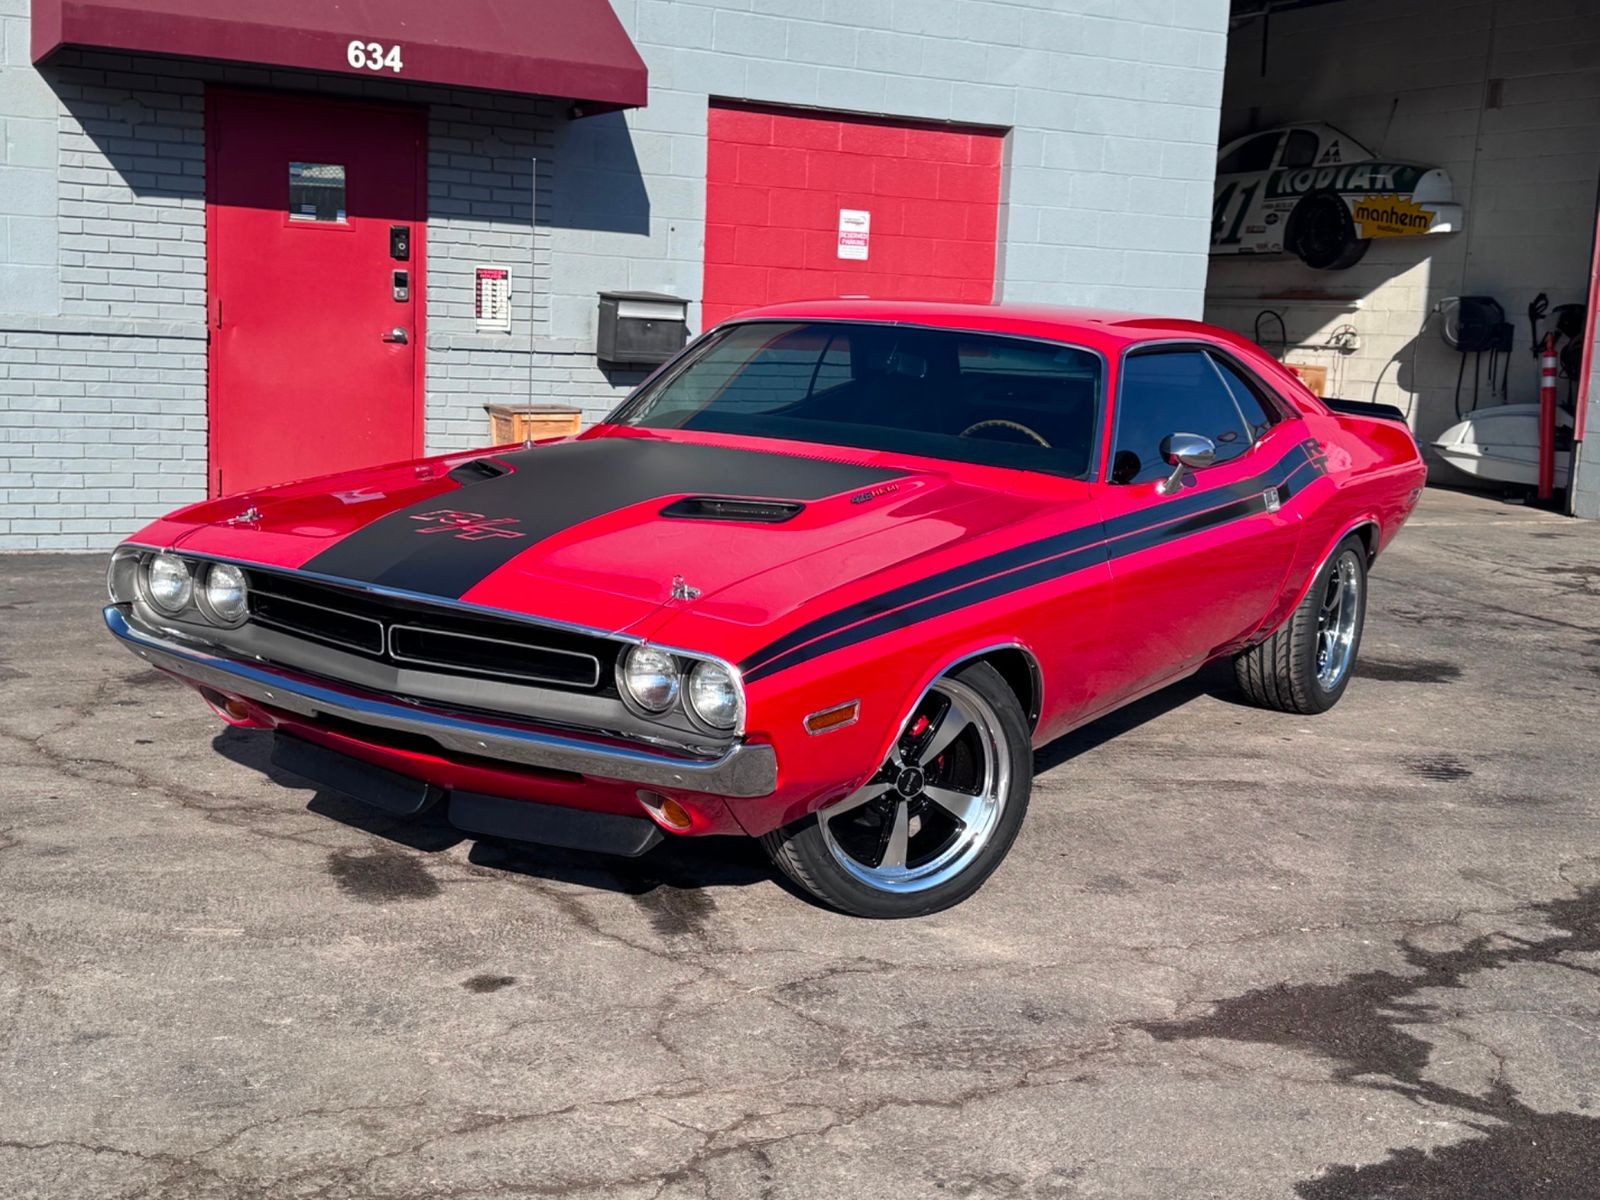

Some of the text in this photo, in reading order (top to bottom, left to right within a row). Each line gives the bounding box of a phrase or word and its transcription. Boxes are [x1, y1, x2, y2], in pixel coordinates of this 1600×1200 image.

[347, 40, 404, 73] 634
[1276, 165, 1402, 193] KODIAK
[1355, 204, 1429, 229] manheim
